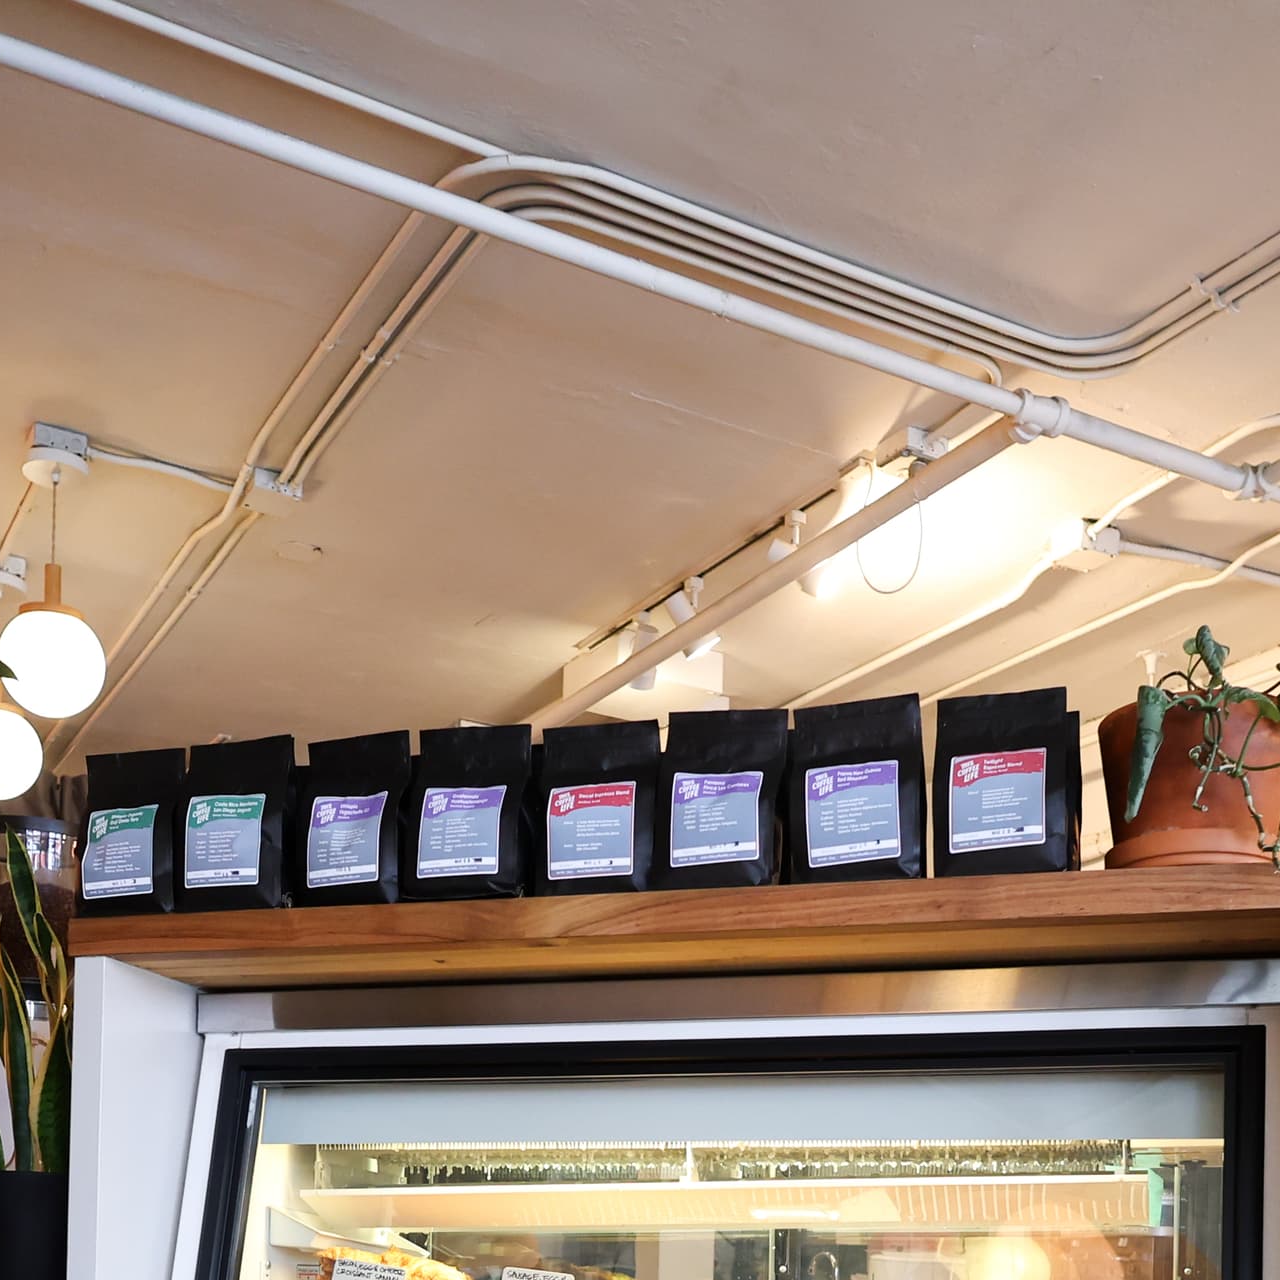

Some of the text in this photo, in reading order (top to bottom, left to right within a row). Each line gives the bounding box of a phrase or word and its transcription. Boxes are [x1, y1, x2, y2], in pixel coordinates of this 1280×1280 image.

[960, 760, 974, 768] THIS
[957, 764, 979, 777] COFFEE
[815, 772, 828, 780] THIS
[963, 773, 978, 783] LIFE
[812, 775, 833, 790] COFFEE
[679, 783, 699, 794] COFFEE
[818, 785, 833, 797] LIFE
[558, 792, 570, 800] THIS
[684, 791, 698, 800] LIFE
[428, 798, 448, 808] COFFEE
[555, 795, 575, 807] COFFEE
[316, 807, 336, 818] COFFEE
[560, 803, 574, 813] LIFE
